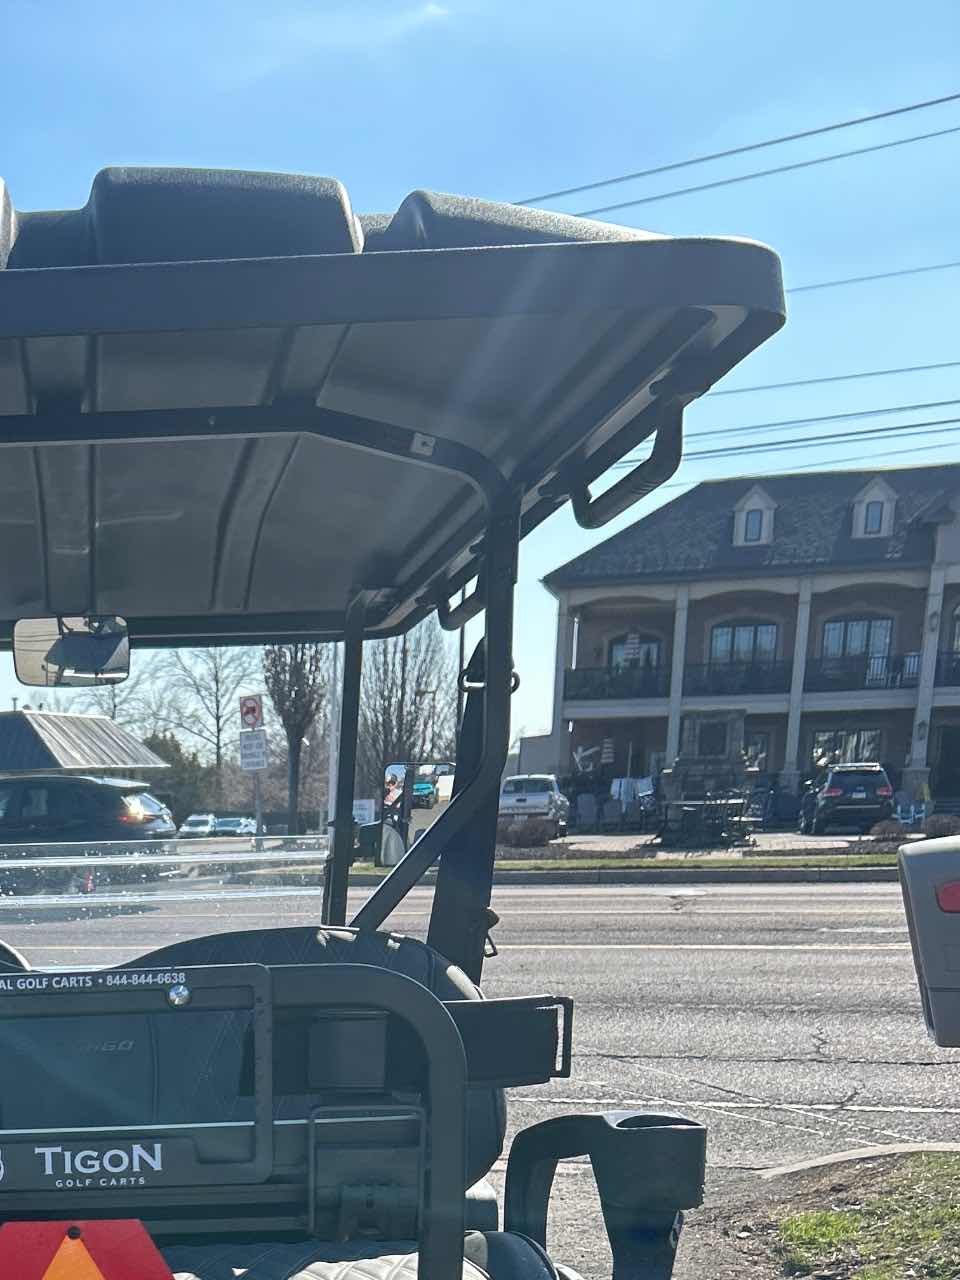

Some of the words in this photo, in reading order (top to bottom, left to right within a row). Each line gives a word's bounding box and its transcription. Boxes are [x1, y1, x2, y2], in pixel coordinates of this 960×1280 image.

[16, 978, 49, 989] GOLF
[52, 976, 92, 988] CARTS
[106, 972, 186, 986] 844-844-6638
[55, 1179, 93, 1188] GOLF
[99, 1176, 145, 1186] CARTS
